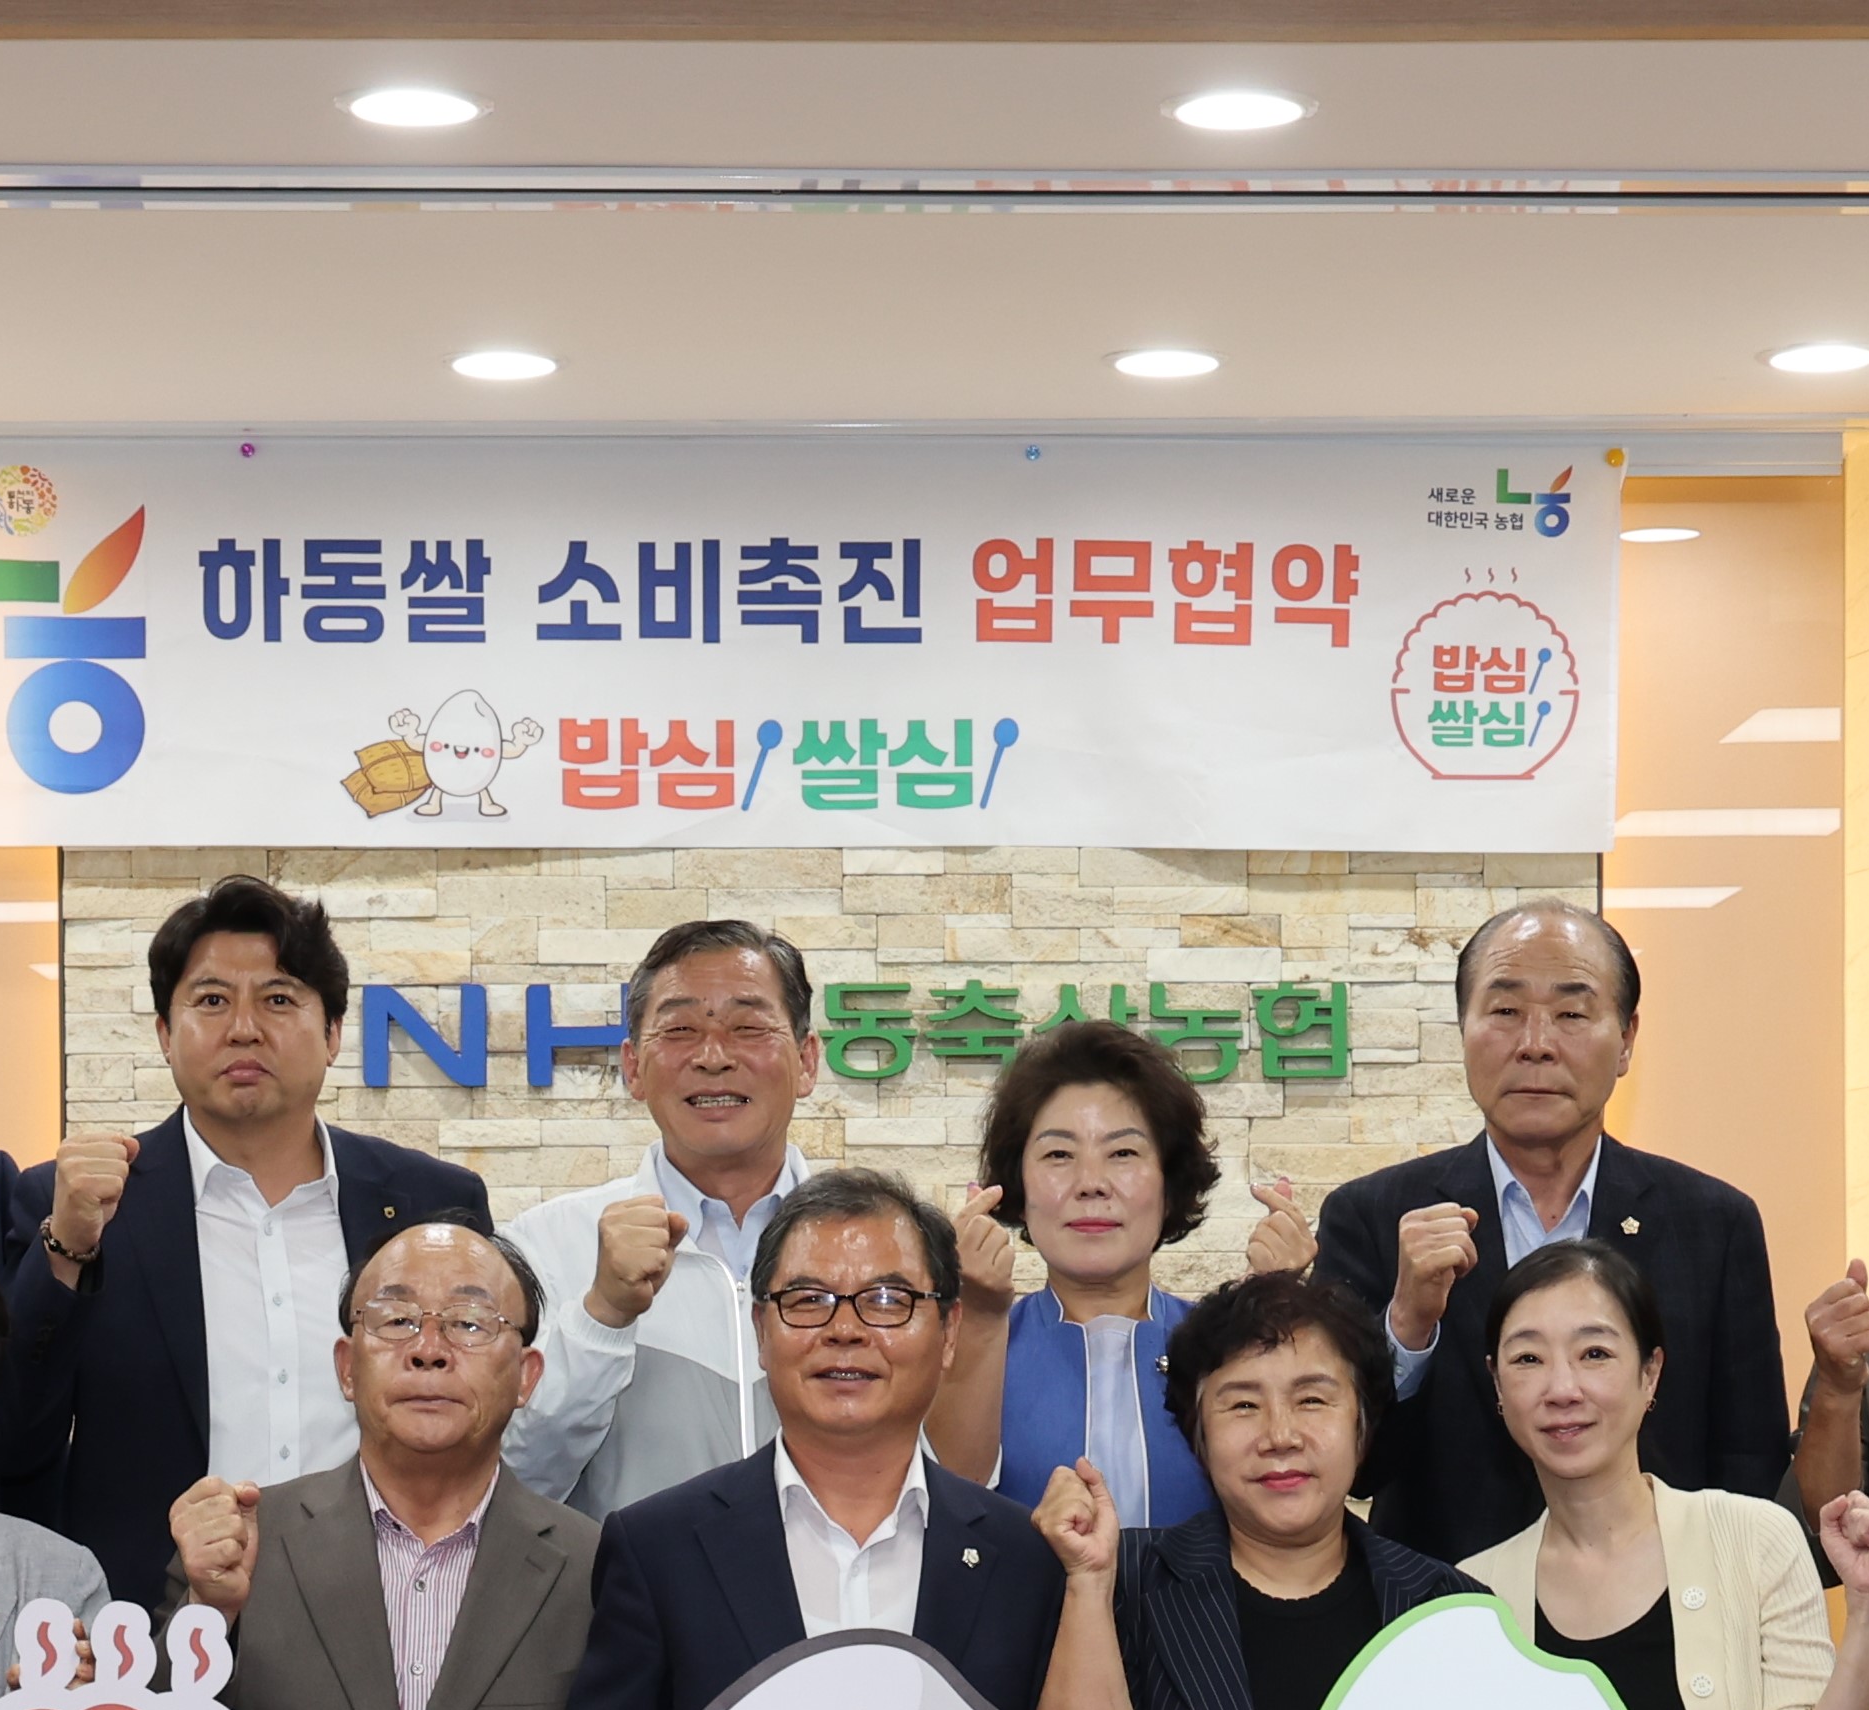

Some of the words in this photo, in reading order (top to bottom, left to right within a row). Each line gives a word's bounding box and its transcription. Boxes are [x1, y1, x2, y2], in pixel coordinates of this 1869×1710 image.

[1427, 487, 1476, 505] 새로운
[1427, 510, 1489, 530] 대한민국
[1493, 512, 1524, 531] 농협
[199, 538, 491, 643] 하동쌀
[536, 538, 922, 644] 소비촉진
[972, 537, 1360, 648] 업무협약
[1432, 645, 1526, 694] 밥심
[1427, 699, 1526, 747] 쌀심
[559, 717, 735, 810] 밥심
[792, 718, 973, 811] 쌀심
[363, 984, 629, 1087] NH
